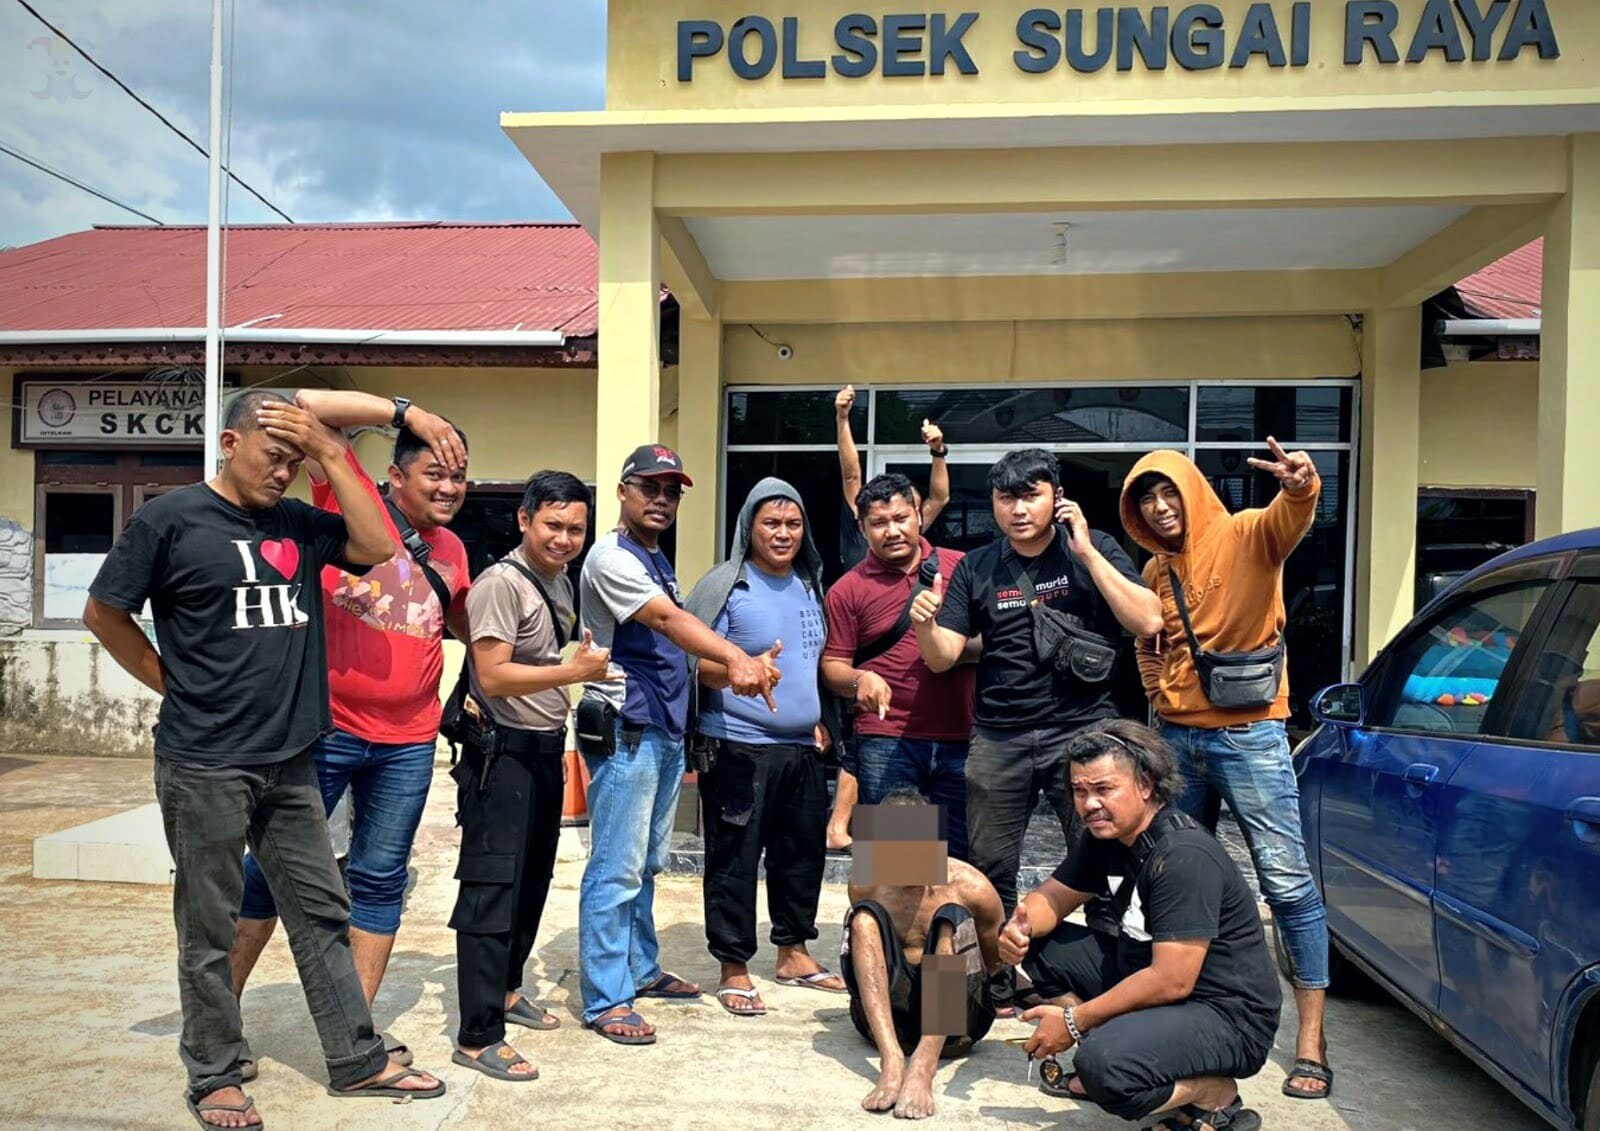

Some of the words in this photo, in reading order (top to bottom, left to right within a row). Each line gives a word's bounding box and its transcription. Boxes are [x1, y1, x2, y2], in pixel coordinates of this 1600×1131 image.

[677, 13, 979, 82] POLSEK
[1013, 2, 1312, 74] SUNGAI
[1343, 0, 1561, 66] RAYA
[89, 390, 205, 406] PELAYANA
[231, 540, 260, 583] I
[1036, 575, 1068, 591] murid
[231, 583, 309, 629] HK
